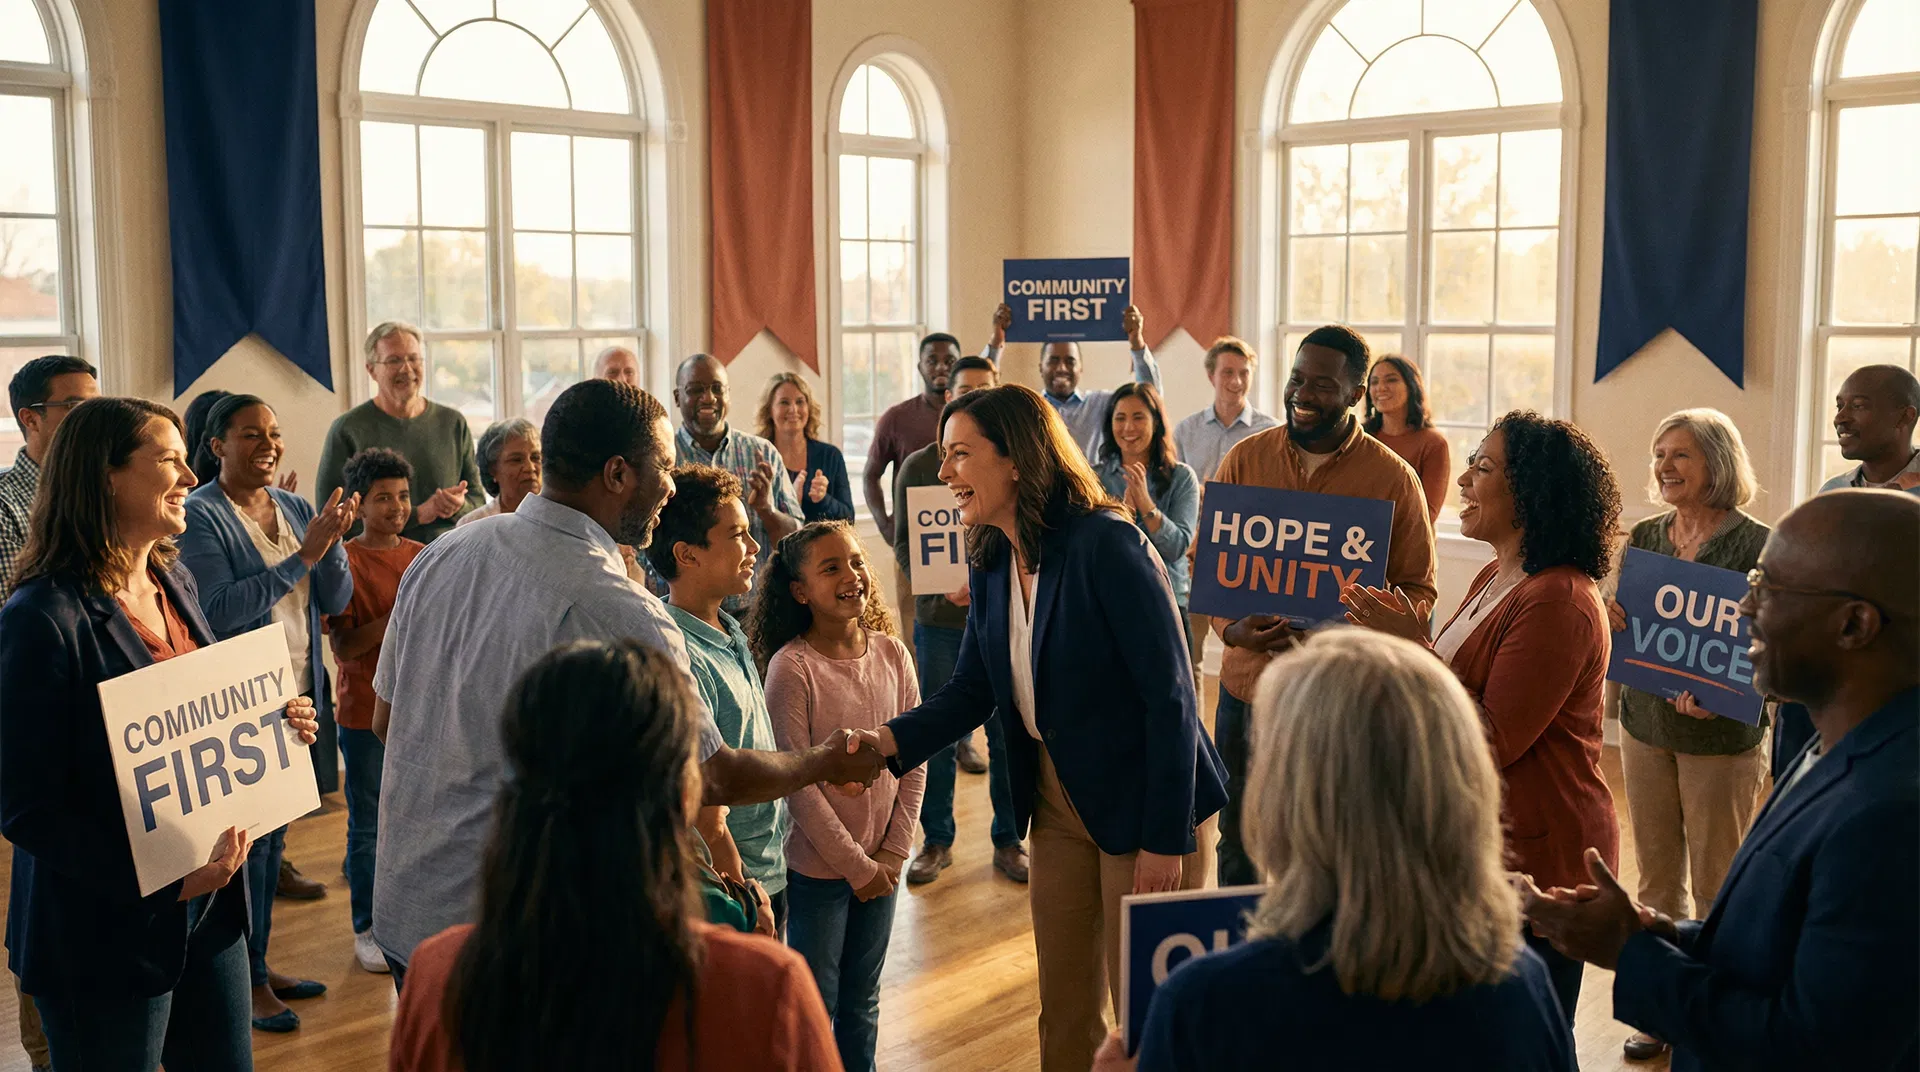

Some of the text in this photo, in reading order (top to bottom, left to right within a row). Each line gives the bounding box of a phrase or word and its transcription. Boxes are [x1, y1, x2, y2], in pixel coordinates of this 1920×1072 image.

[1008, 278, 1126, 295] COMMUNITY
[1028, 298, 1107, 321] FIRST
[920, 531, 969, 566] FI
[1211, 510, 1375, 563] HOPE &
[1216, 551, 1363, 602] UNITY
[1654, 584, 1742, 638] OUR
[1631, 616, 1753, 685] VOICE
[124, 667, 284, 754] COMMUNITY
[133, 707, 291, 833] FIRST
